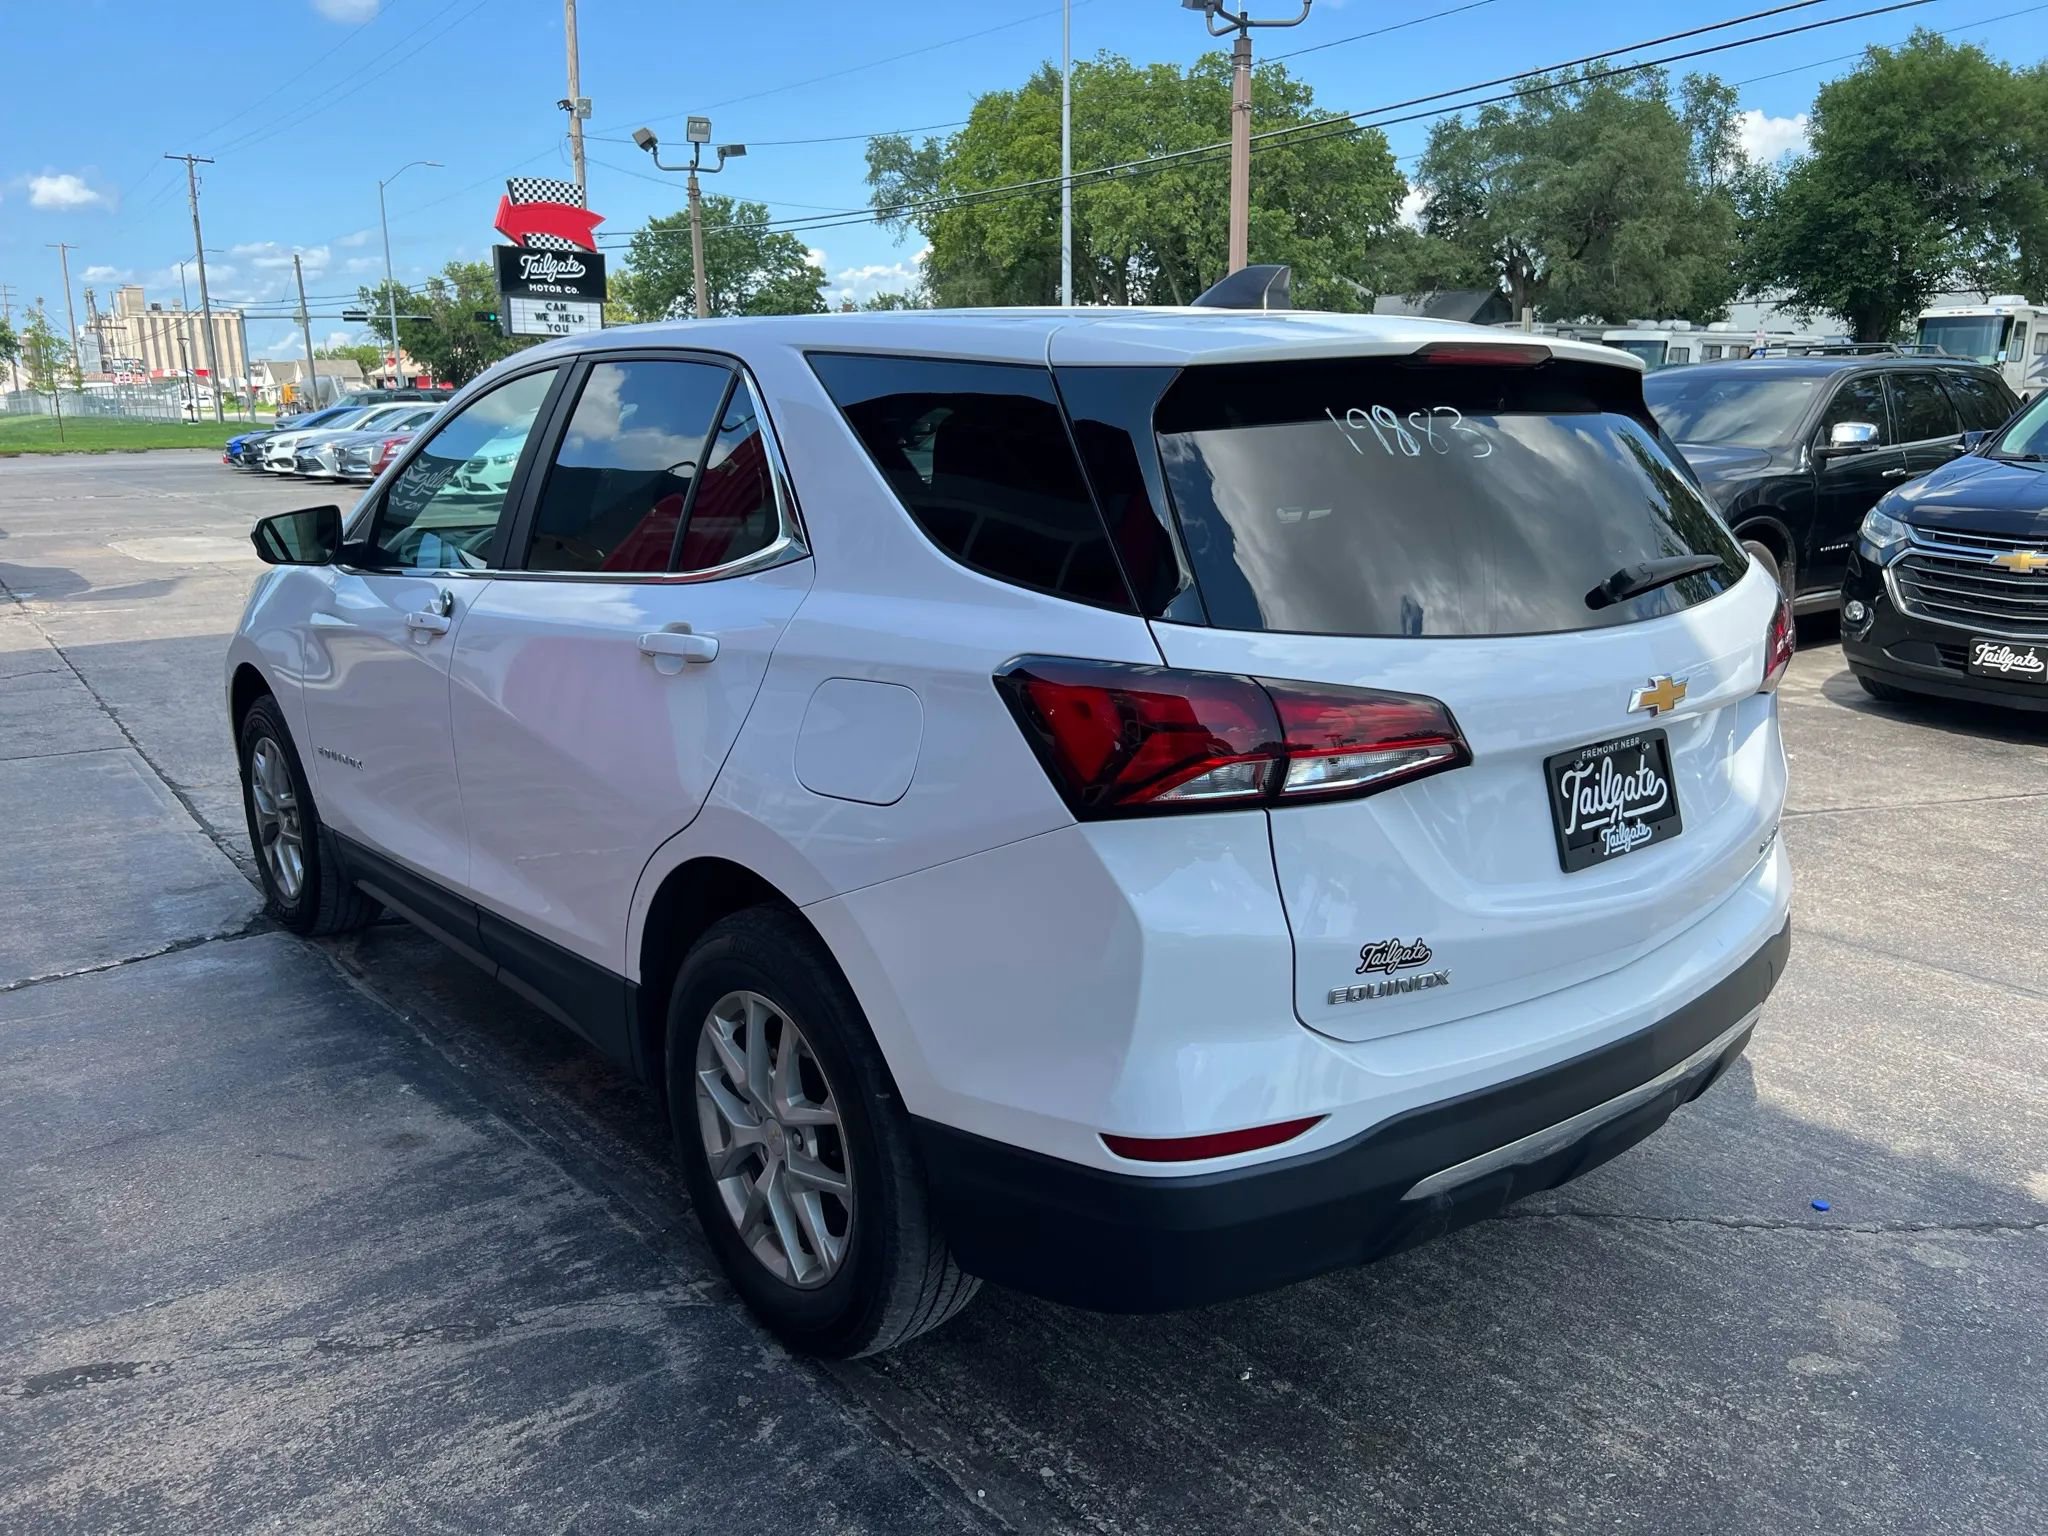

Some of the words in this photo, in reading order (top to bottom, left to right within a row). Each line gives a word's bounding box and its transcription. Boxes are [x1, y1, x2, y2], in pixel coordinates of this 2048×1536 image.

[520, 252, 586, 282] Tailgate
[529, 284, 562, 293] MOTOR
[564, 286, 580, 294] CO.
[534, 312, 550, 322] WE
[558, 313, 585, 323] HELP
[545, 302, 567, 312] CAN
[546, 323, 569, 333] YOU
[1972, 642, 2045, 673] Tailgate
[1581, 742, 1619, 760] FREMONT
[1620, 736, 1640, 750] NEBR
[1561, 754, 1668, 835] Tailgate
[1601, 818, 1653, 856] Tailgate
[1356, 938, 1432, 975] Tailgate
[1327, 968, 1453, 1005] EQUINOX
